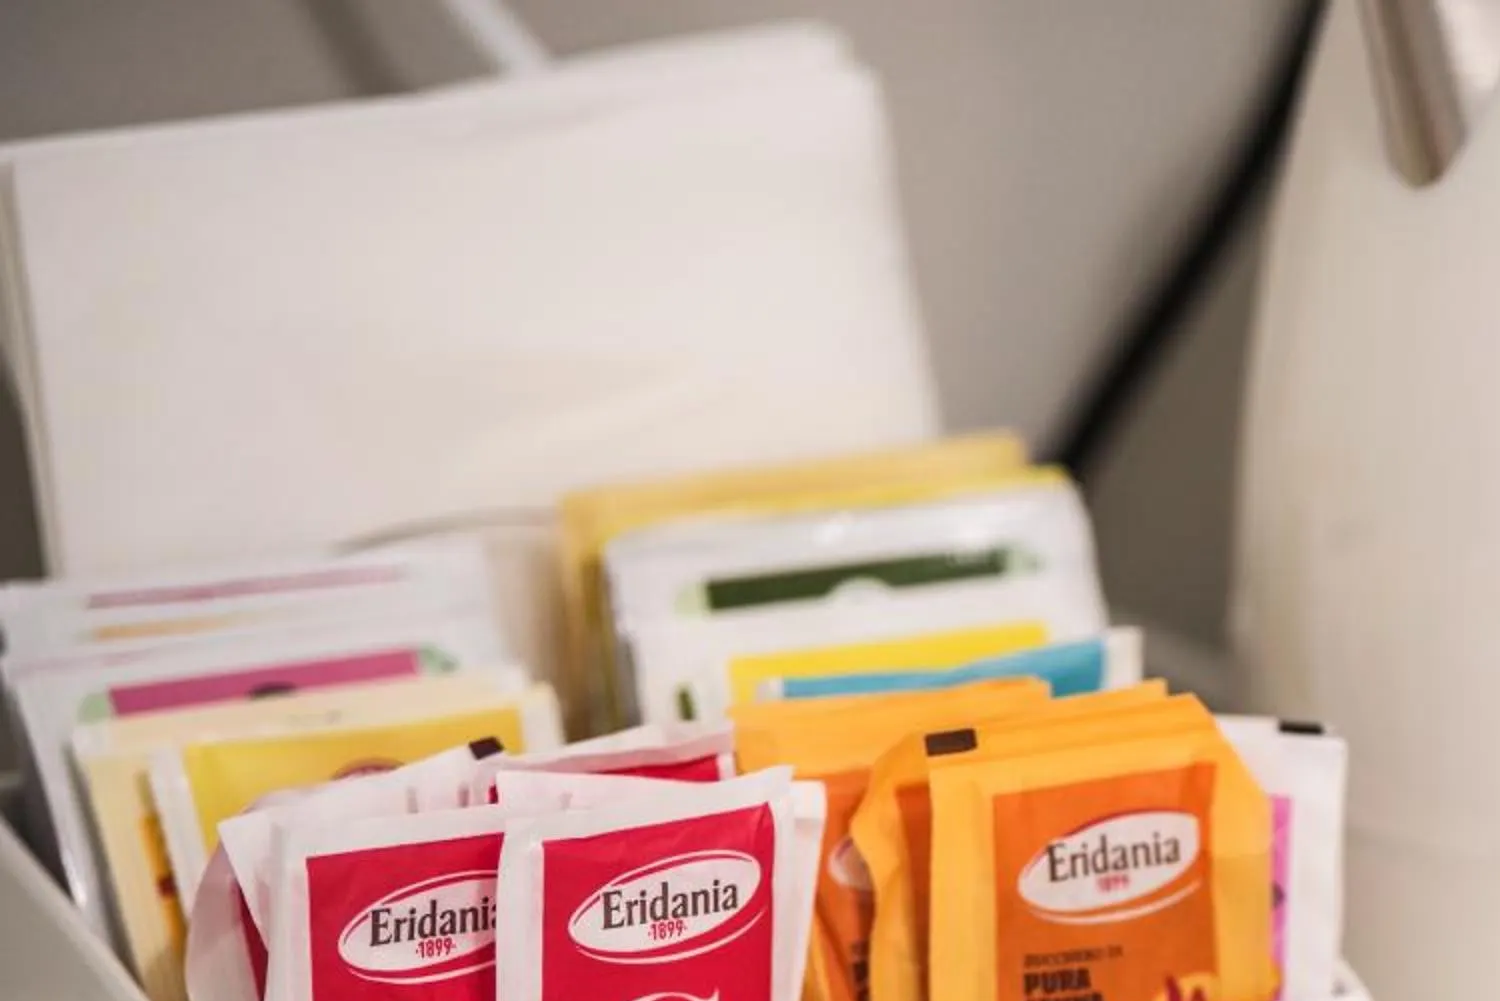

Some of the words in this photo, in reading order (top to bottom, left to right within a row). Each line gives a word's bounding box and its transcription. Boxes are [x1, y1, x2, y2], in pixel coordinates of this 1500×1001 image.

[1046, 831, 1181, 882] Eridania
[601, 879, 738, 930] Eridania
[1023, 968, 1091, 995] PURA
